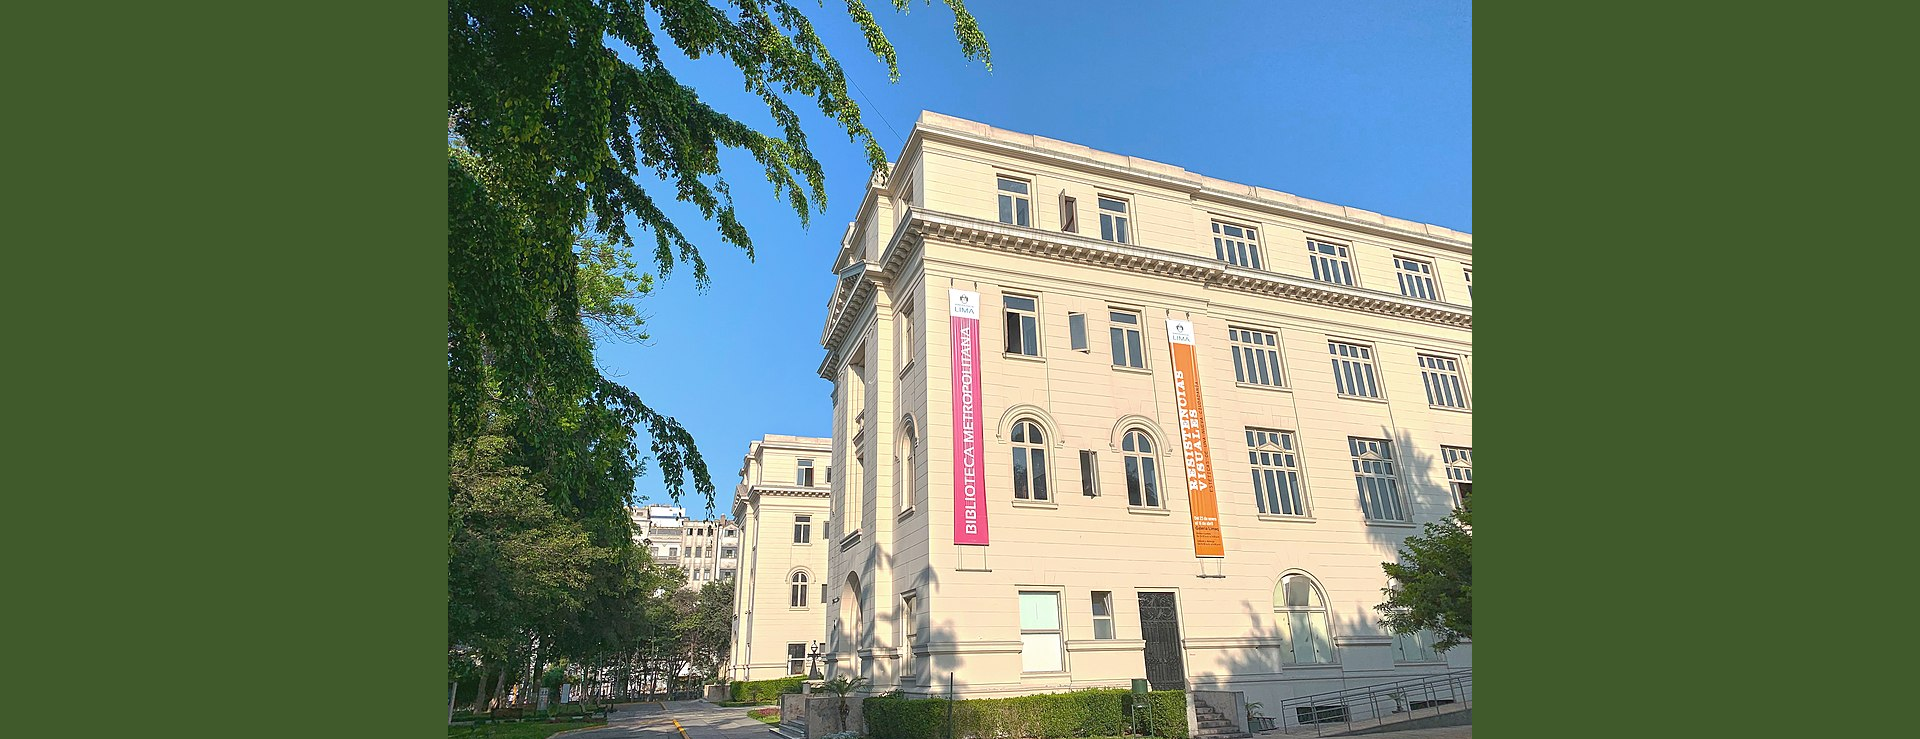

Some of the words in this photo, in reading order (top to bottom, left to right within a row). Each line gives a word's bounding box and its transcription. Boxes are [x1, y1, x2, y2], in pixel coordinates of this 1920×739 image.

[954, 306, 975, 315] LIMA
[1172, 335, 1191, 343] LIMA
[960, 326, 975, 443] METROPOLITANA
[1175, 370, 1198, 491] RESISTENCIAS
[1189, 409, 1208, 491] VISUALES
[964, 446, 977, 535] BIBLIOTECA
